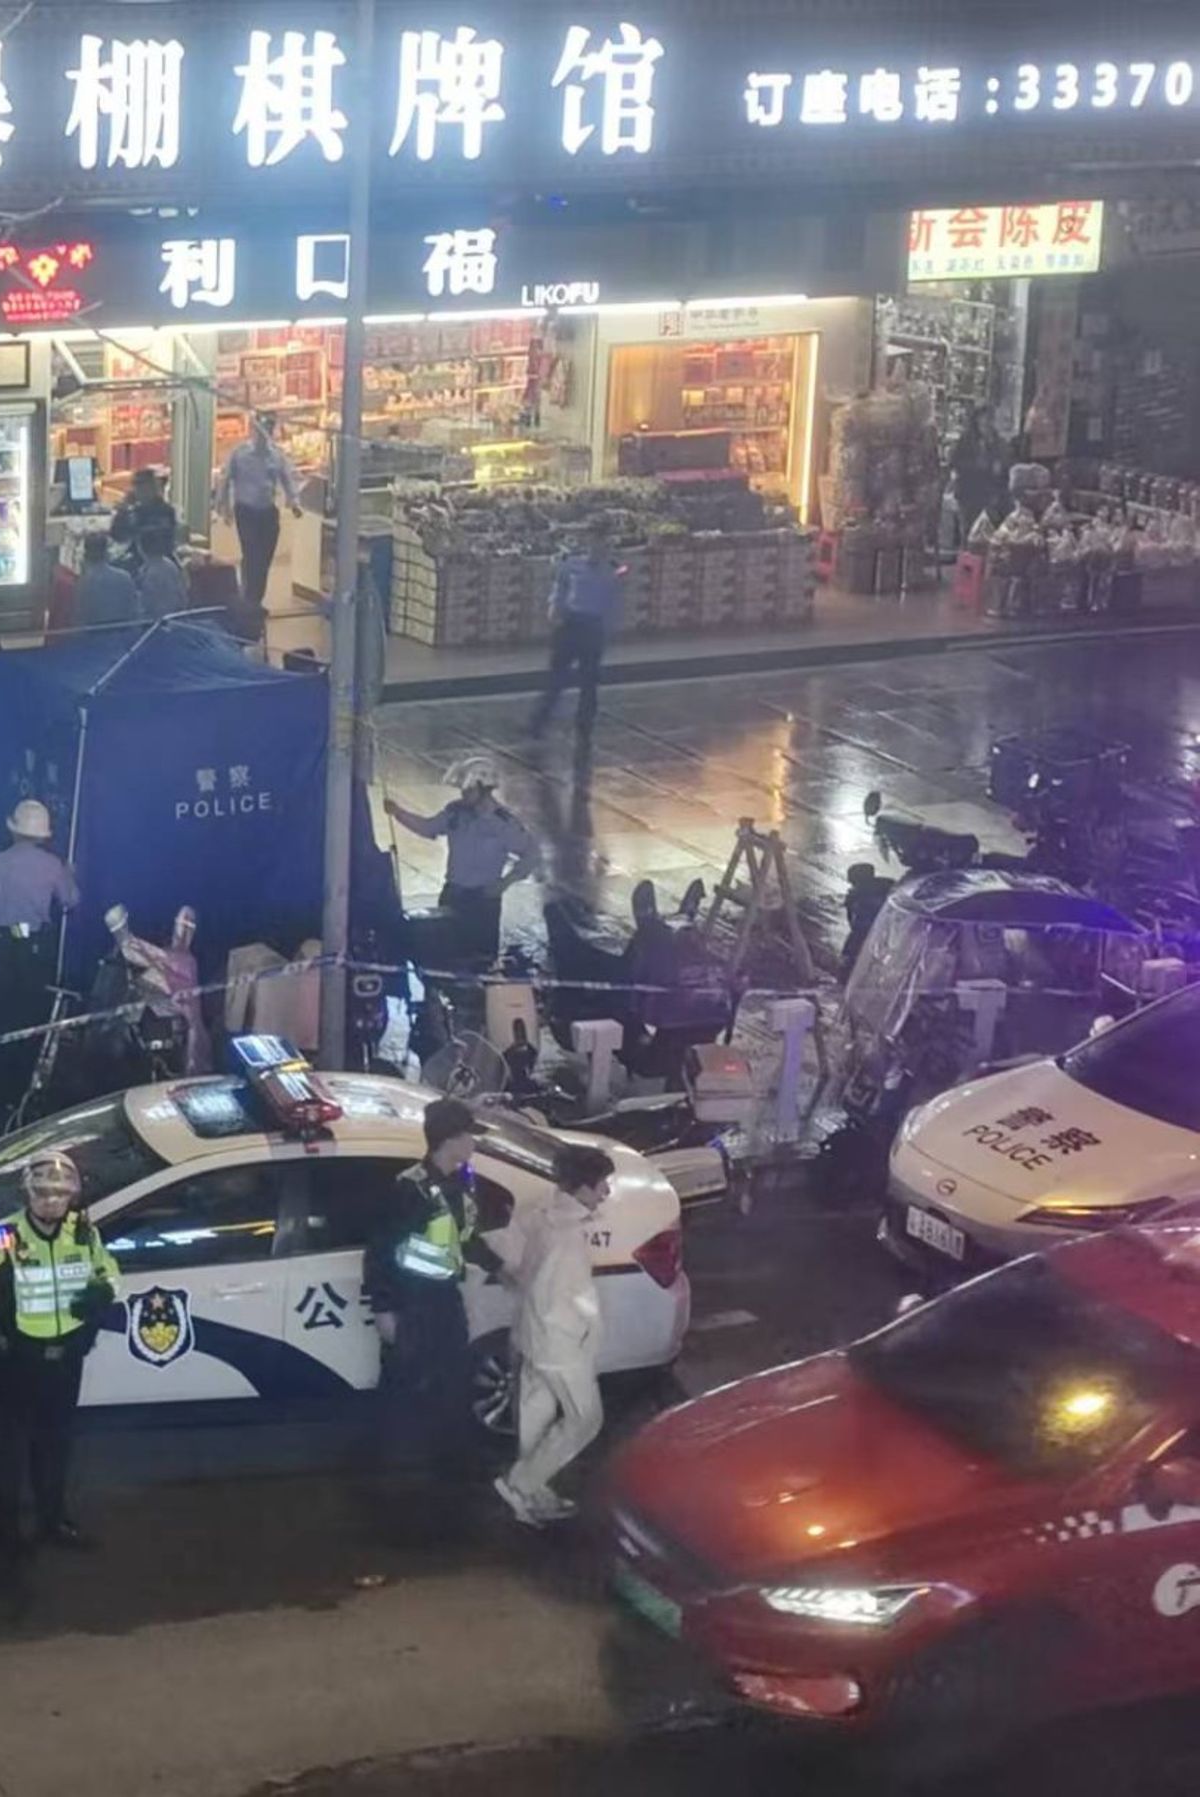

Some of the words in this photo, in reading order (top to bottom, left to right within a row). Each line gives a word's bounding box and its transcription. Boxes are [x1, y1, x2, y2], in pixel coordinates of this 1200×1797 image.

[158, 228, 497, 309] 利口福
[521, 282, 600, 307] LIKOFU
[176, 792, 272, 819] POLICE
[962, 1124, 1054, 1171] POLICE
[295, 1282, 375, 1330] 公
